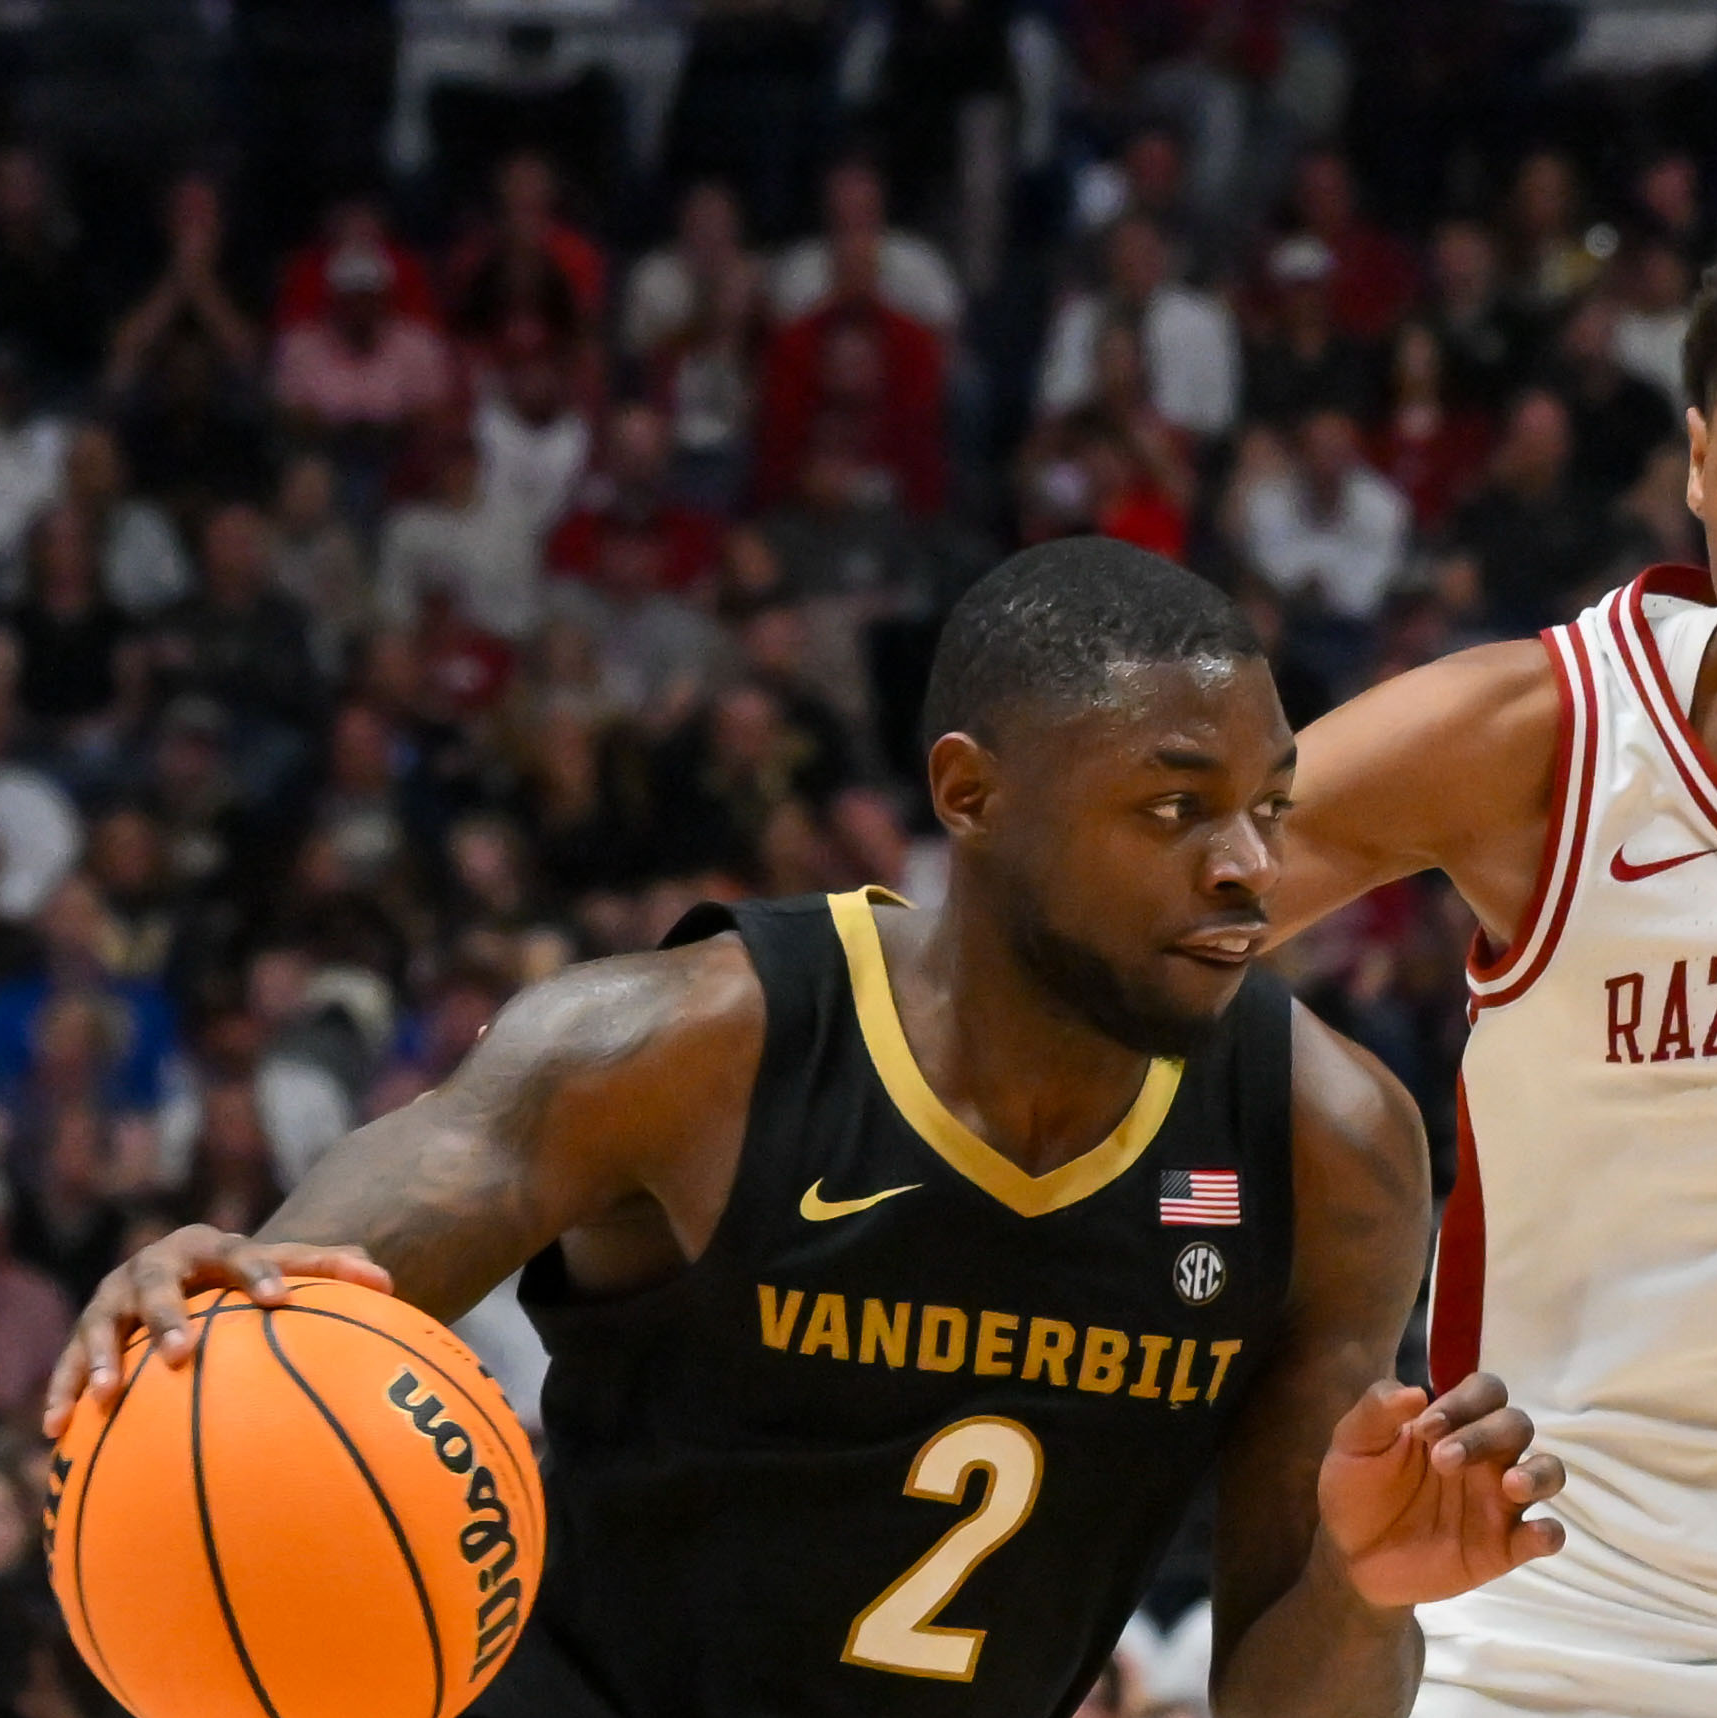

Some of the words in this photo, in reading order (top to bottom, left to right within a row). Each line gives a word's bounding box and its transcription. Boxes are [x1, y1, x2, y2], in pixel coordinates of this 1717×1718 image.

[1179, 1247, 1223, 1300] SEC
[757, 1284, 1244, 1408] VANDERBILT
[840, 1415, 1045, 1683] 2
